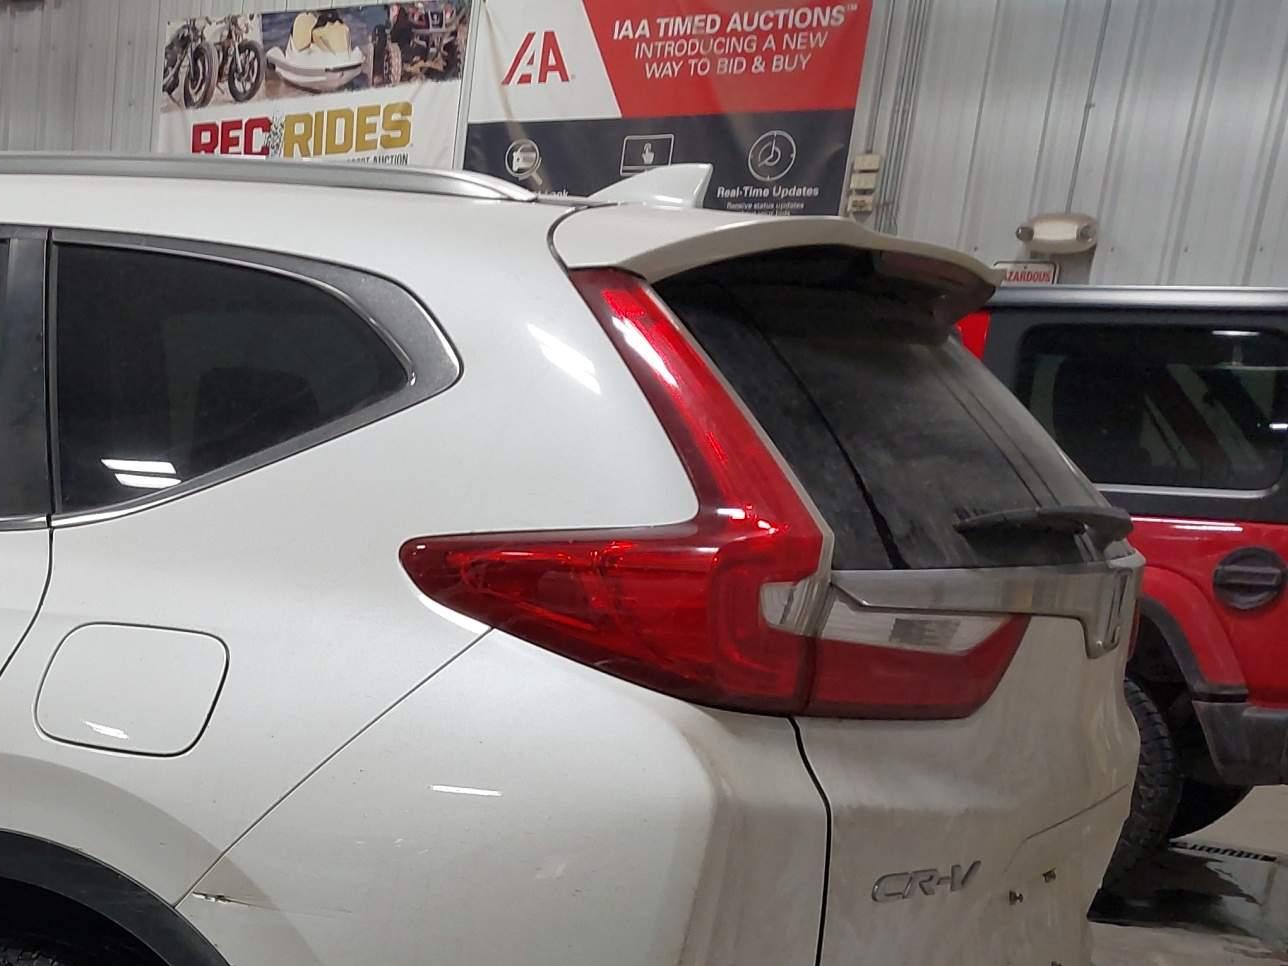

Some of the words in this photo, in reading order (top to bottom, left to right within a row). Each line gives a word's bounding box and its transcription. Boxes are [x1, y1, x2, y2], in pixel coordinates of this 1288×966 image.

[613, 18, 650, 40] IAA
[657, 14, 721, 37] TIMED
[635, 34, 757, 60] INTRODUCING
[762, 38, 777, 52] A
[782, 31, 828, 51] NEW
[645, 60, 683, 79] WAY
[688, 58, 711, 77] TO
[716, 56, 747, 75] BID
[751, 55, 765, 74] &
[772, 53, 812, 73] BUY
[282, 101, 413, 158] RIDES
[716, 185, 770, 199] Real-Time
[772, 185, 820, 199] Updates
[872, 860, 982, 902] CR-V
